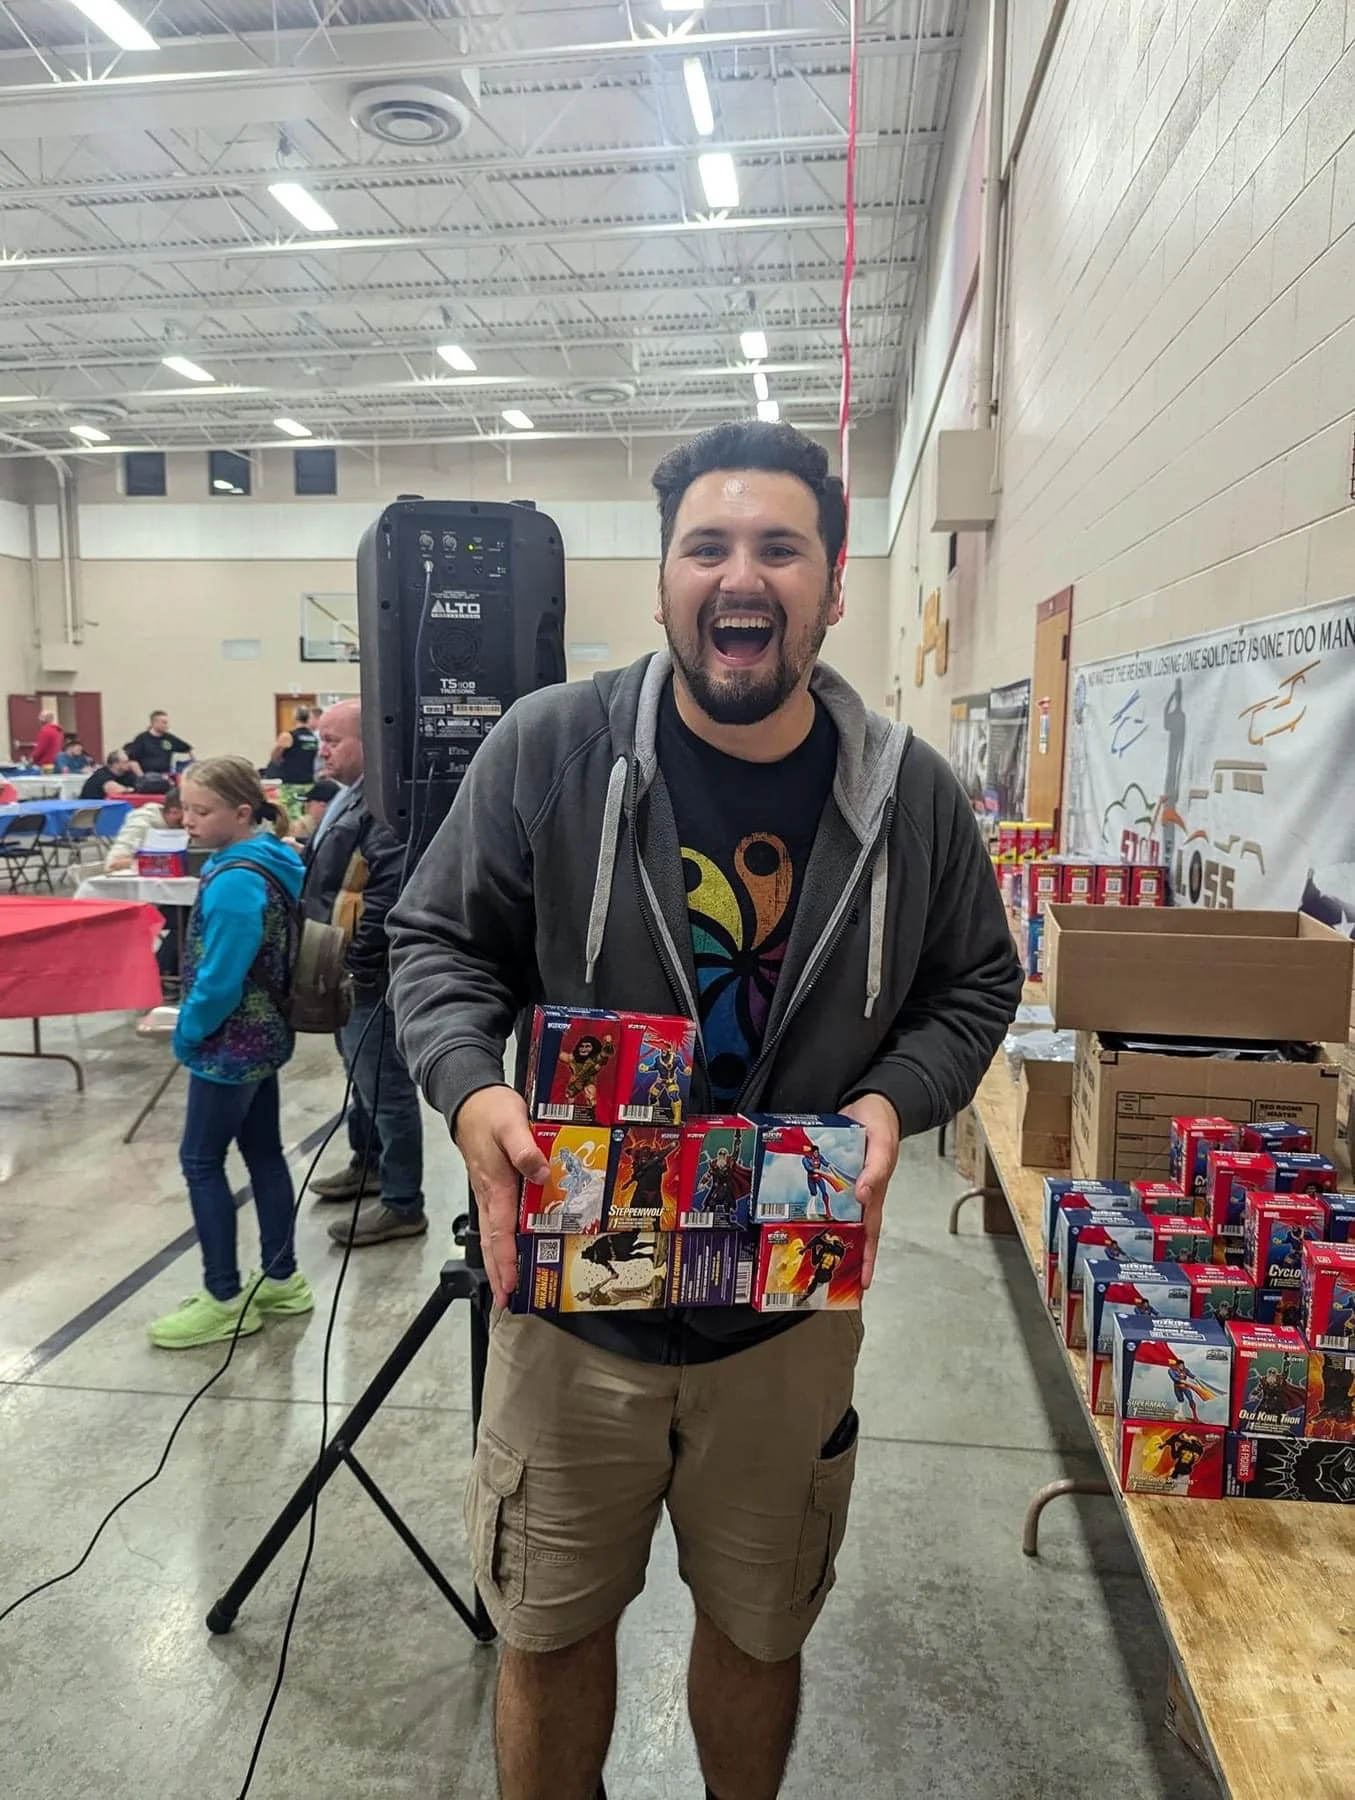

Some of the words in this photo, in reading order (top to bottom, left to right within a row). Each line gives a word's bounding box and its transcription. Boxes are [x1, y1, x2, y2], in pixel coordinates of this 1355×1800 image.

[431, 600, 480, 614] ALTO
[1181, 650, 1200, 672] ONE
[1202, 639, 1246, 669] SOLDIER
[1247, 637, 1259, 662] IS
[1260, 631, 1285, 660] ONE
[1287, 625, 1316, 656] TOO
[1175, 849, 1236, 910] LOSS
[608, 1204, 665, 1217] STEPPENWOLF
[1239, 1409, 1256, 1420] OLD
[1256, 1410, 1278, 1423] KING
